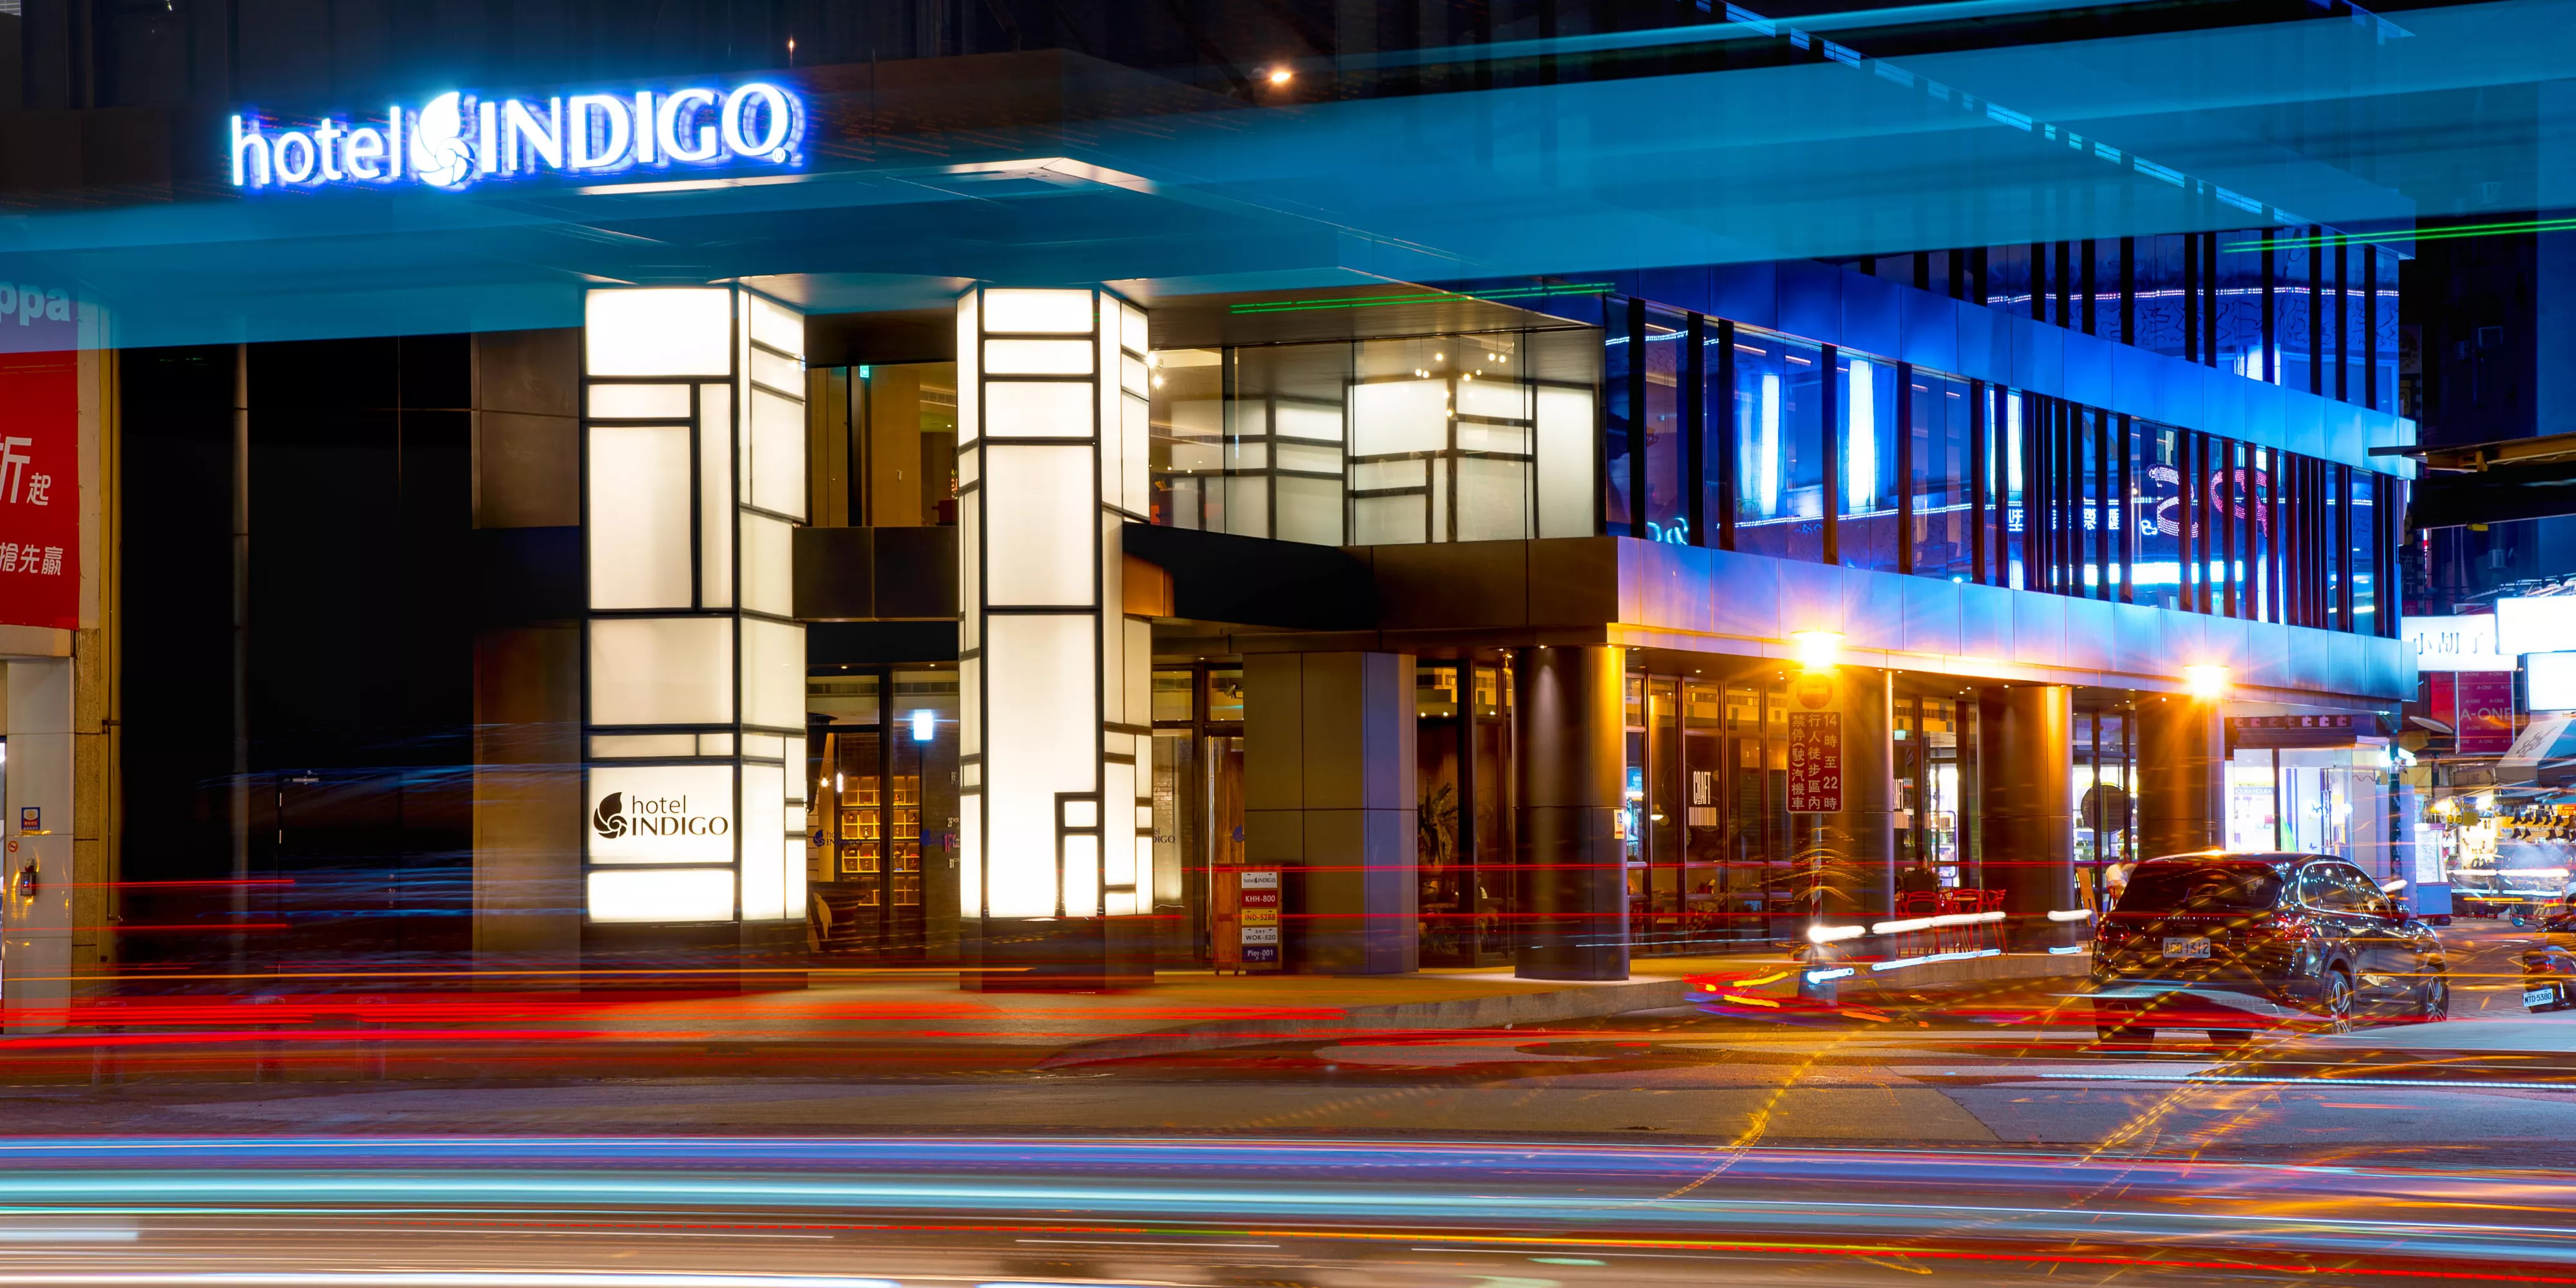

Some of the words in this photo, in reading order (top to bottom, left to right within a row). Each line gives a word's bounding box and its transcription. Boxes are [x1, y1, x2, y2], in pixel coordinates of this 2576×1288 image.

[232, 105, 401, 186] hotel
[480, 82, 790, 173] INDIGO
[2460, 707, 2512, 721] A-ONE
[1808, 714, 1821, 810] 行人徒步區內
[1823, 714, 1837, 810] 14時至22時
[1694, 771, 1711, 804] CRAFT
[632, 795, 686, 814] hotel
[632, 817, 728, 836] INDIGO
[2524, 992, 2552, 1005] MTD-5380
